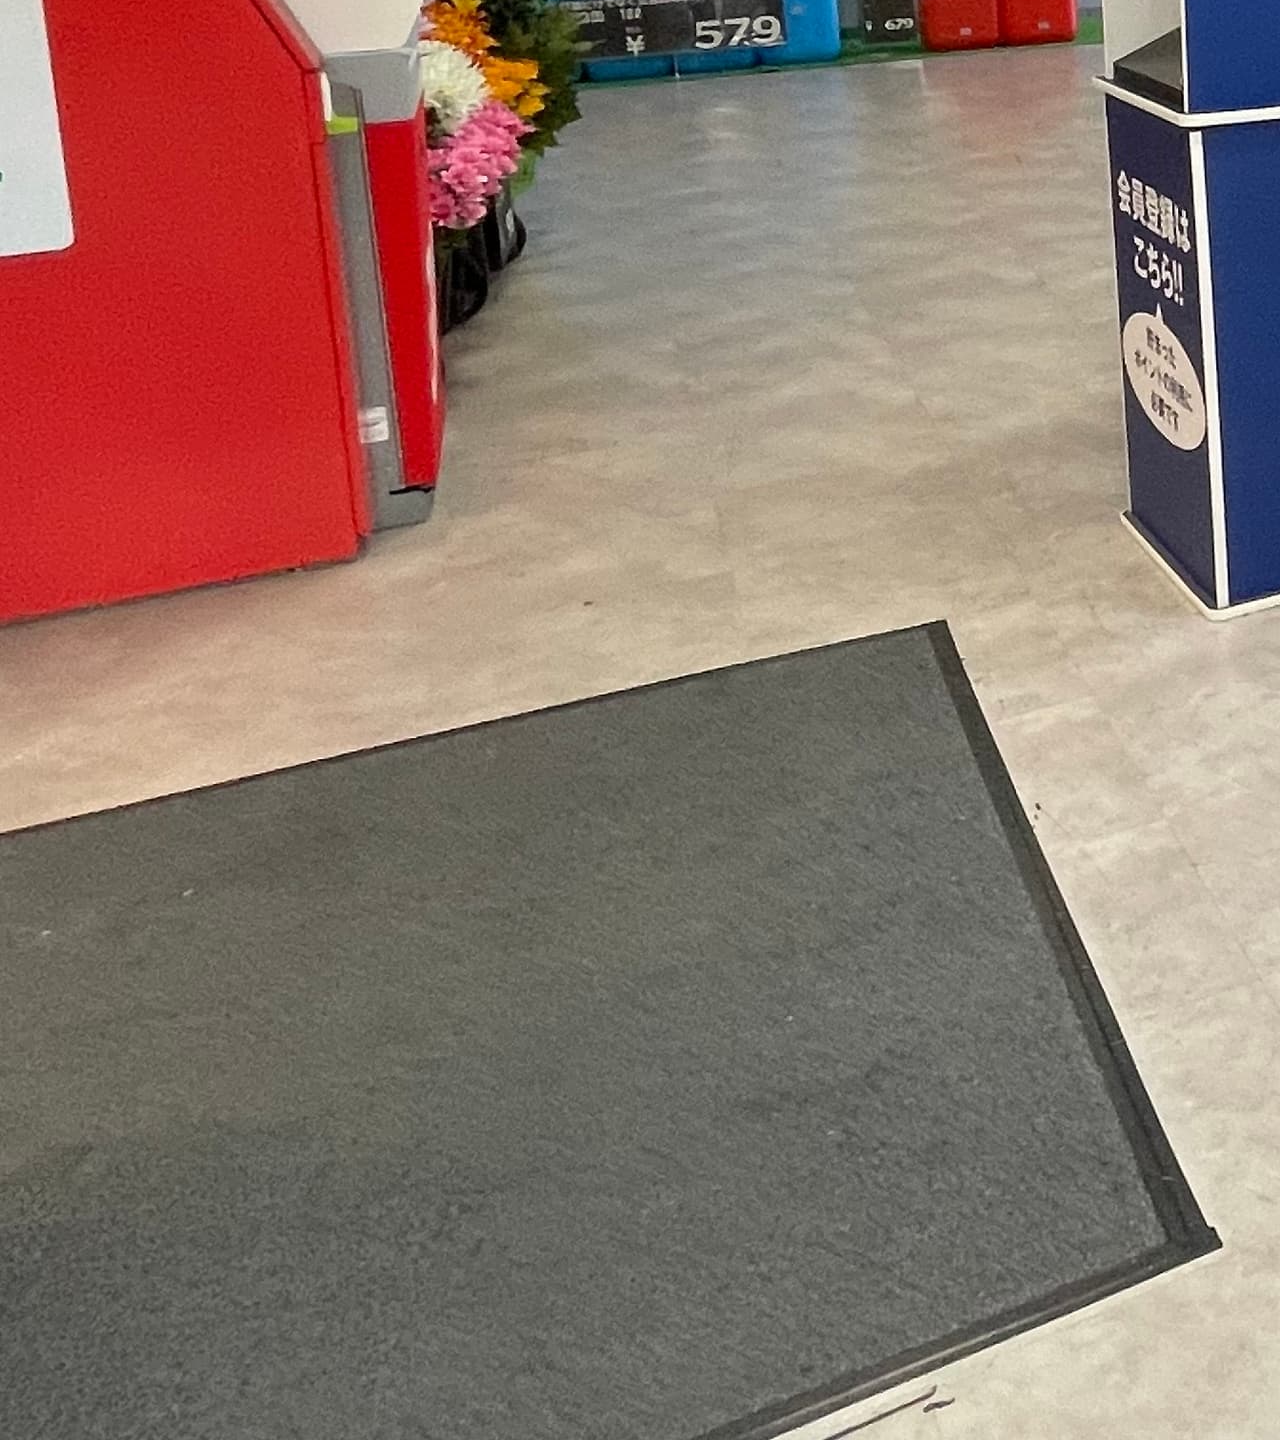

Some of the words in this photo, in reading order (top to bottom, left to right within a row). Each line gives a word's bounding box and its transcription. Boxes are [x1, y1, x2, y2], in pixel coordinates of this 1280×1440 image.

[695, 15, 781, 50] 579
[1117, 169, 1191, 253] 会員登録は
[1132, 235, 1185, 307] こちら!!
